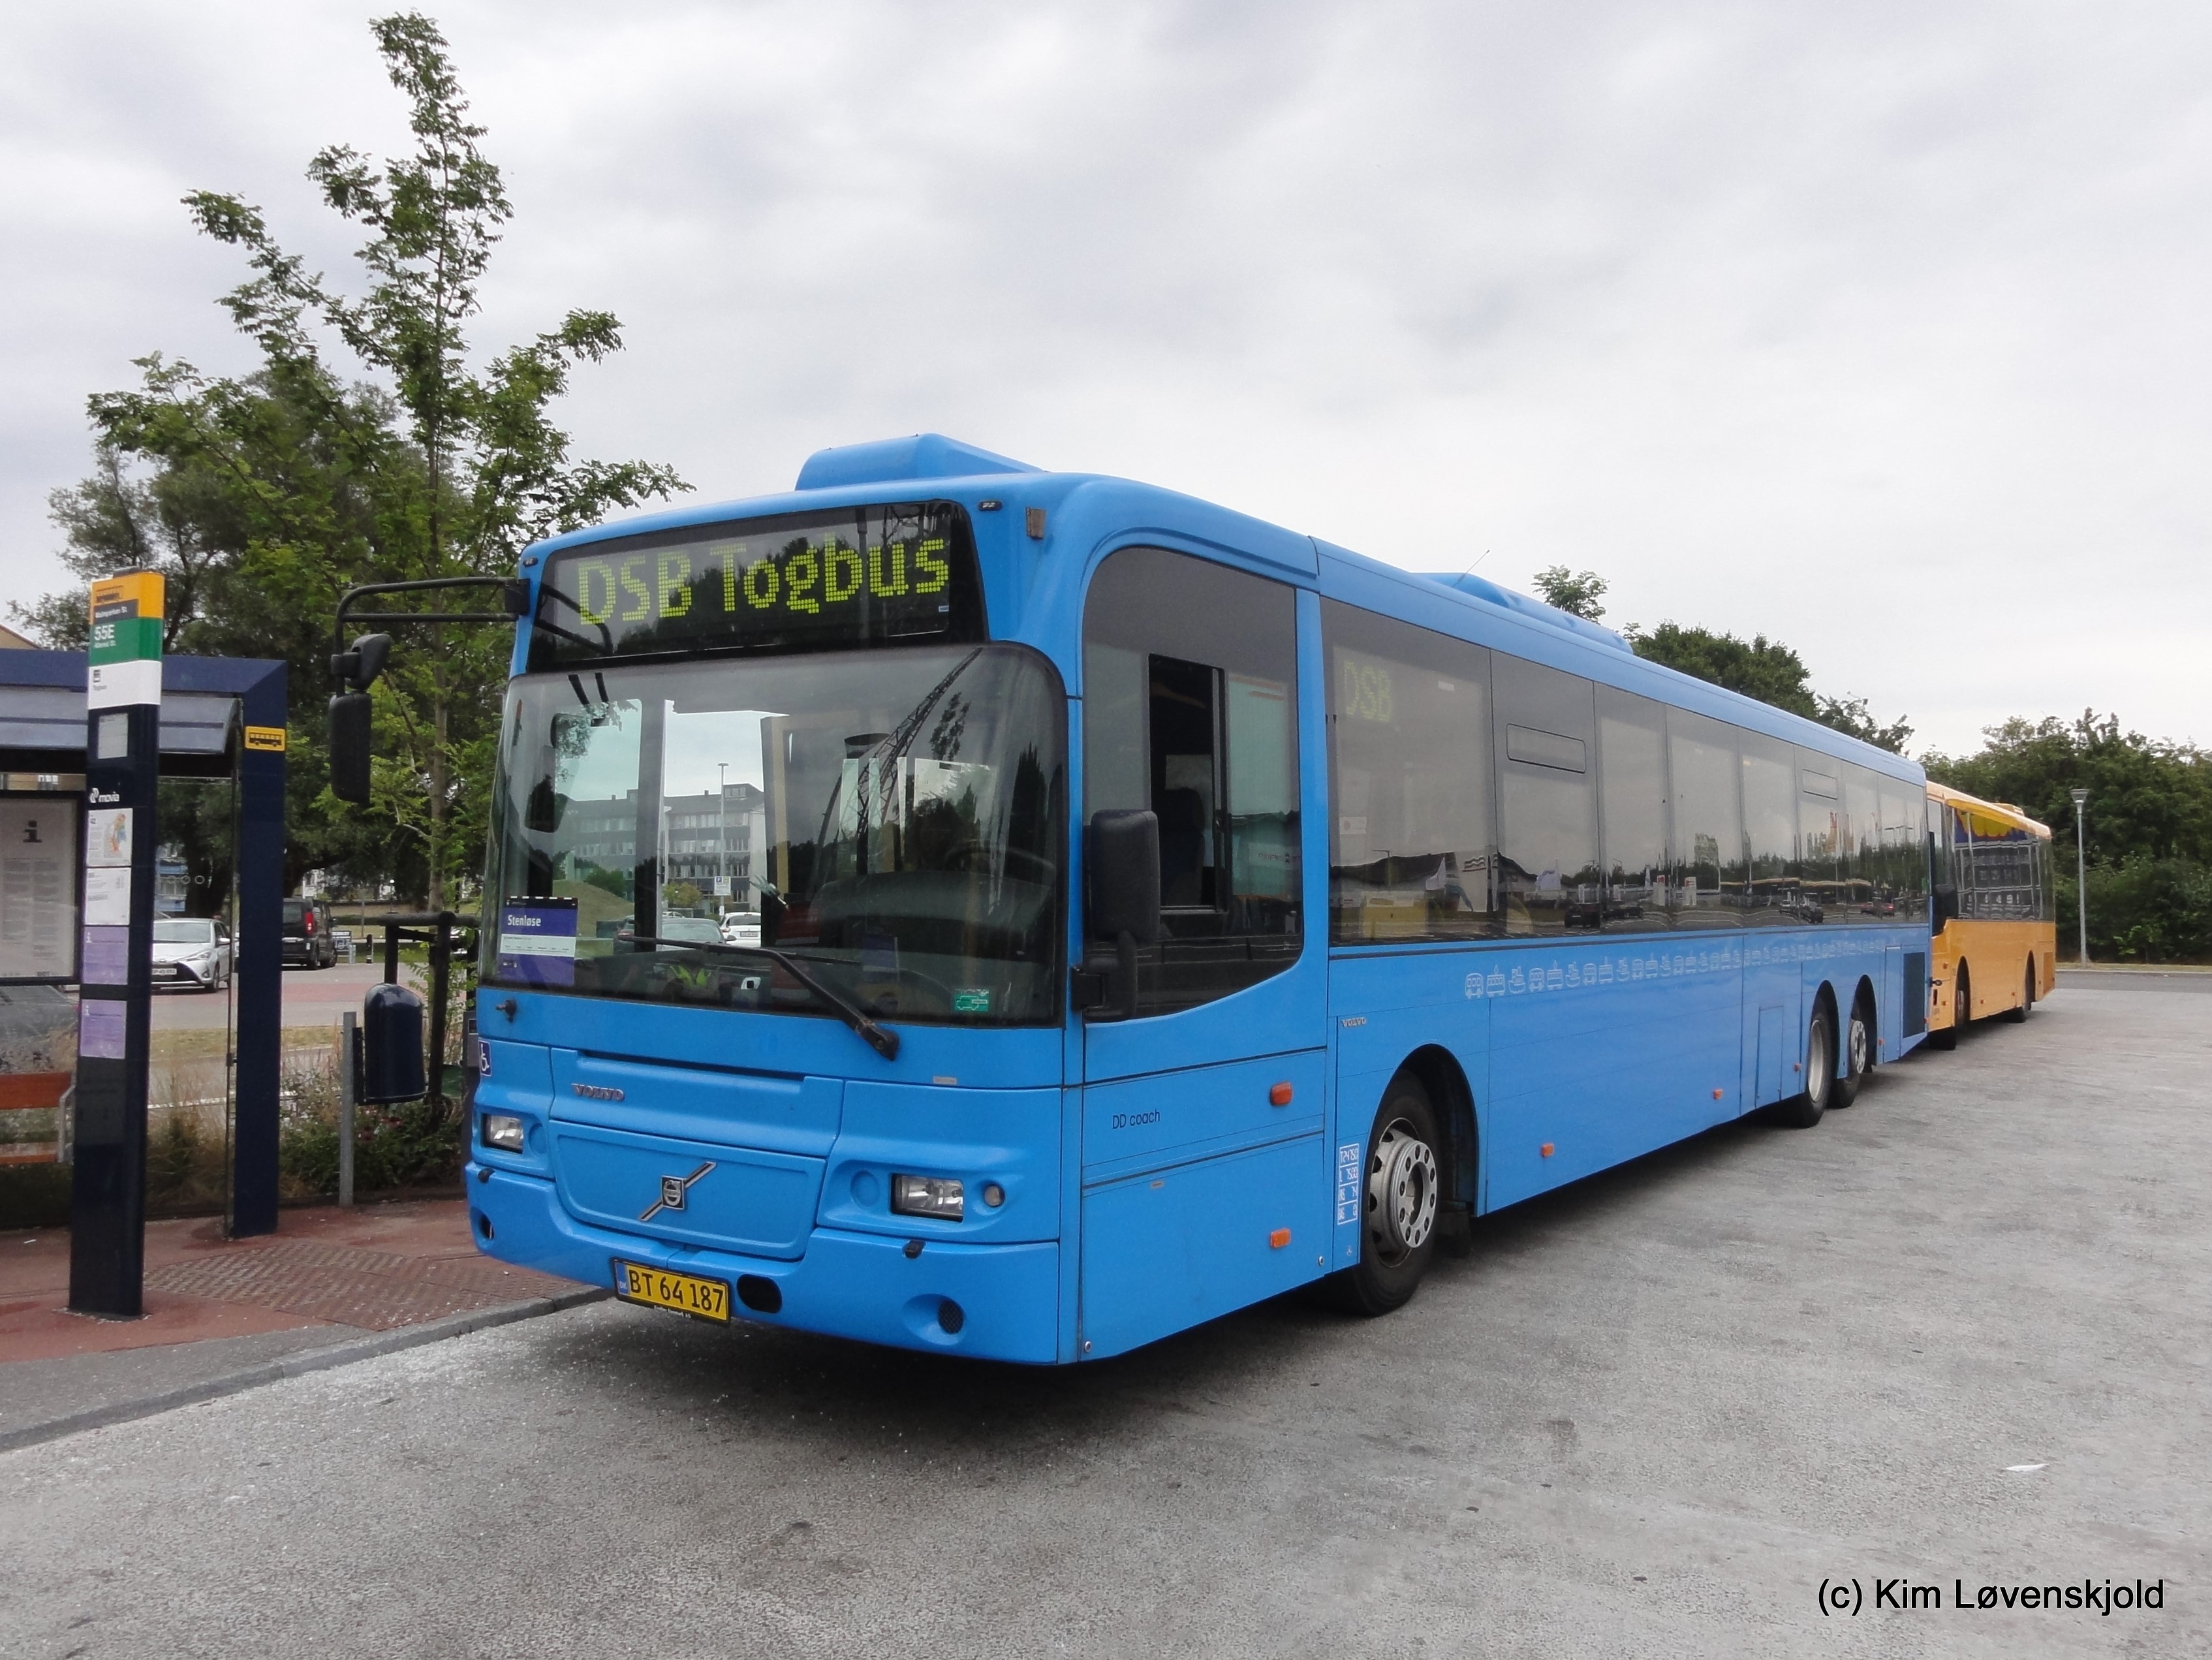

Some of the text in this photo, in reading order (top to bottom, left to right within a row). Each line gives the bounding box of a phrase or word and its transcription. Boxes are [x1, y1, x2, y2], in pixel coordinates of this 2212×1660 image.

[579, 532, 949, 625] DSB Togbus
[94, 624, 115, 640] 55E
[1344, 661, 1392, 722] DSB
[99, 791, 120, 802] movia
[507, 915, 542, 926] Stenløse
[1341, 1017, 1367, 1027] VOLVO
[571, 1084, 624, 1101] VOLVO
[1112, 1109, 1161, 1129] DD coach
[629, 1269, 653, 1297] BT
[660, 1276, 684, 1305] 64
[689, 1283, 724, 1313] 187
